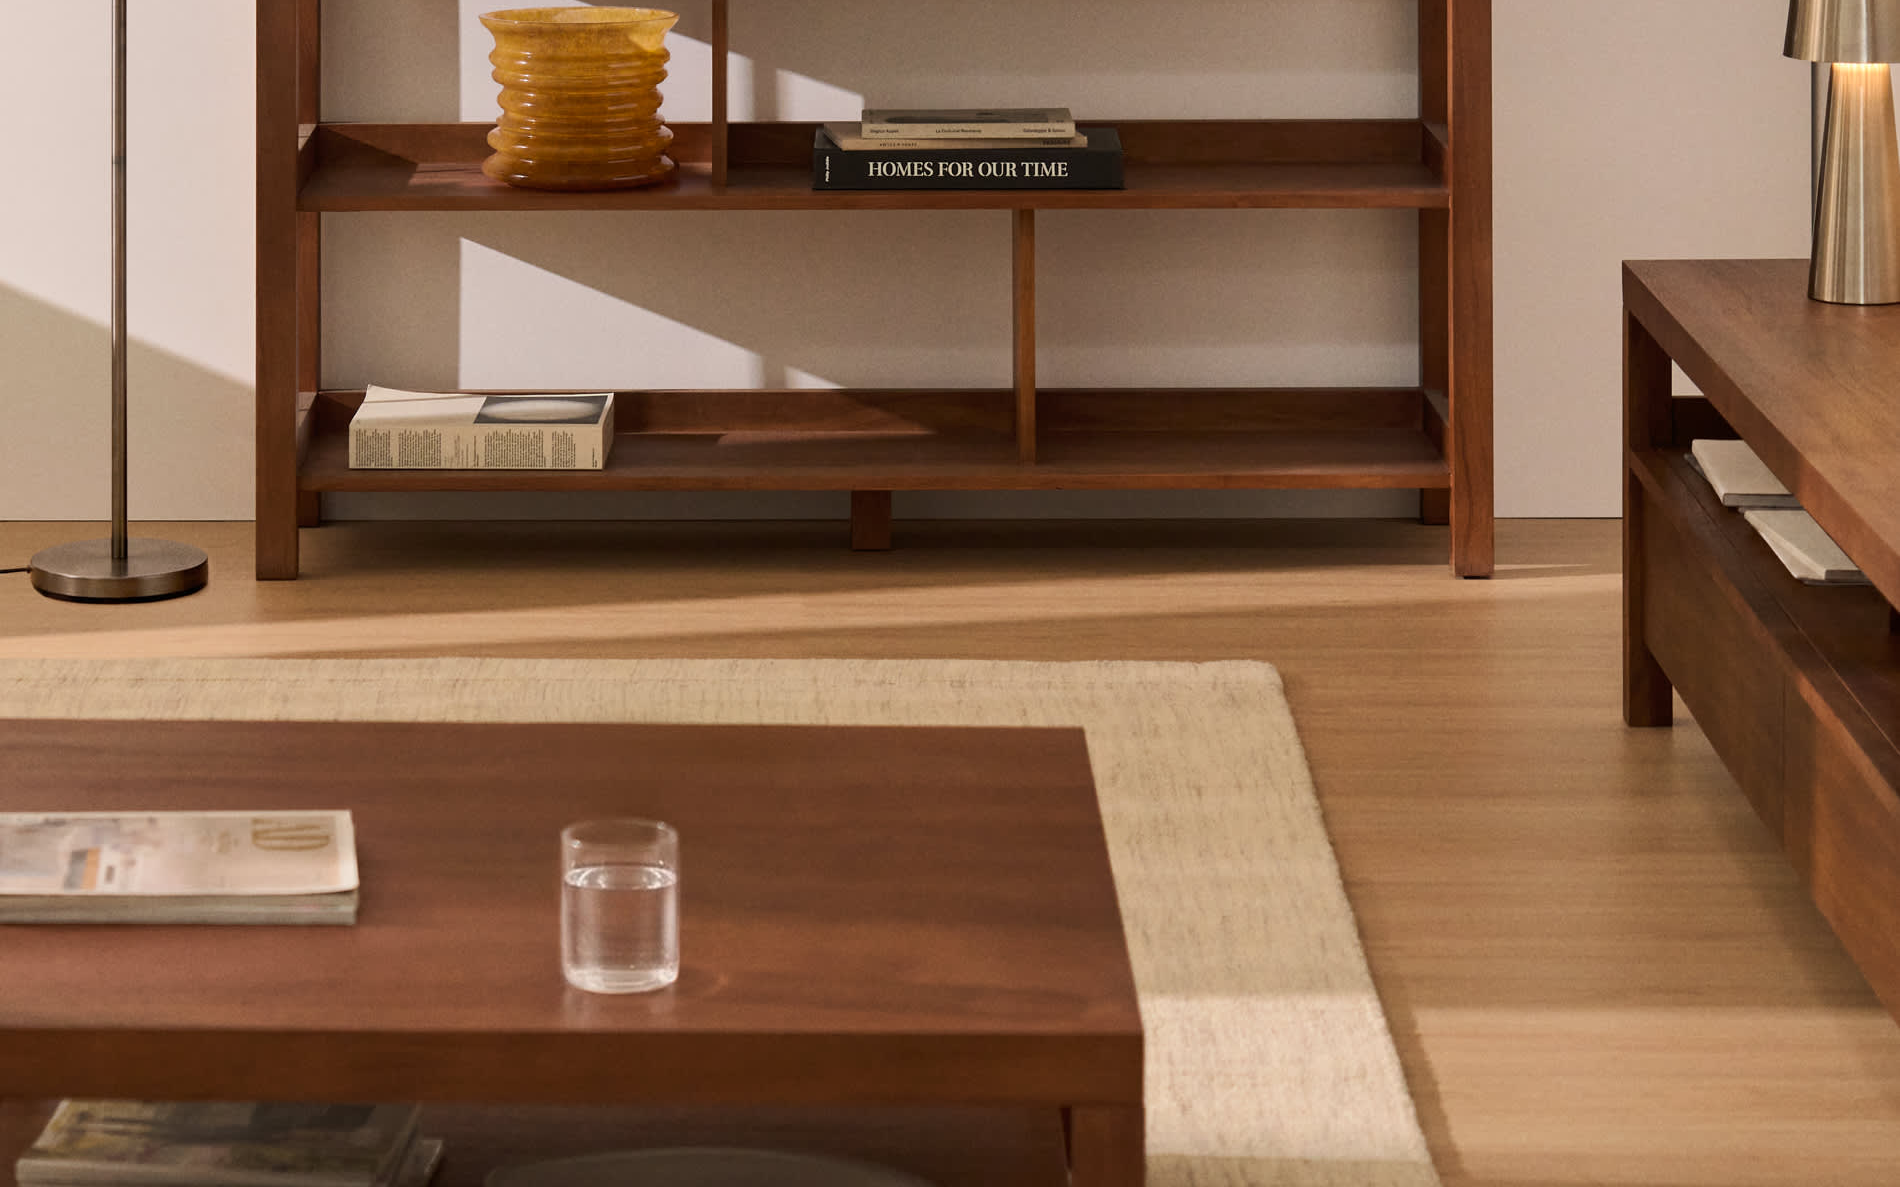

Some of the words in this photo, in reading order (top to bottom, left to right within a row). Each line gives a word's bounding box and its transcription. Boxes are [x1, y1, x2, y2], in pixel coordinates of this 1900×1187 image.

[867, 161, 933, 177] HOMES
[938, 161, 974, 177] FOR
[978, 161, 1017, 177] OUR
[1021, 161, 1069, 177] TIME
